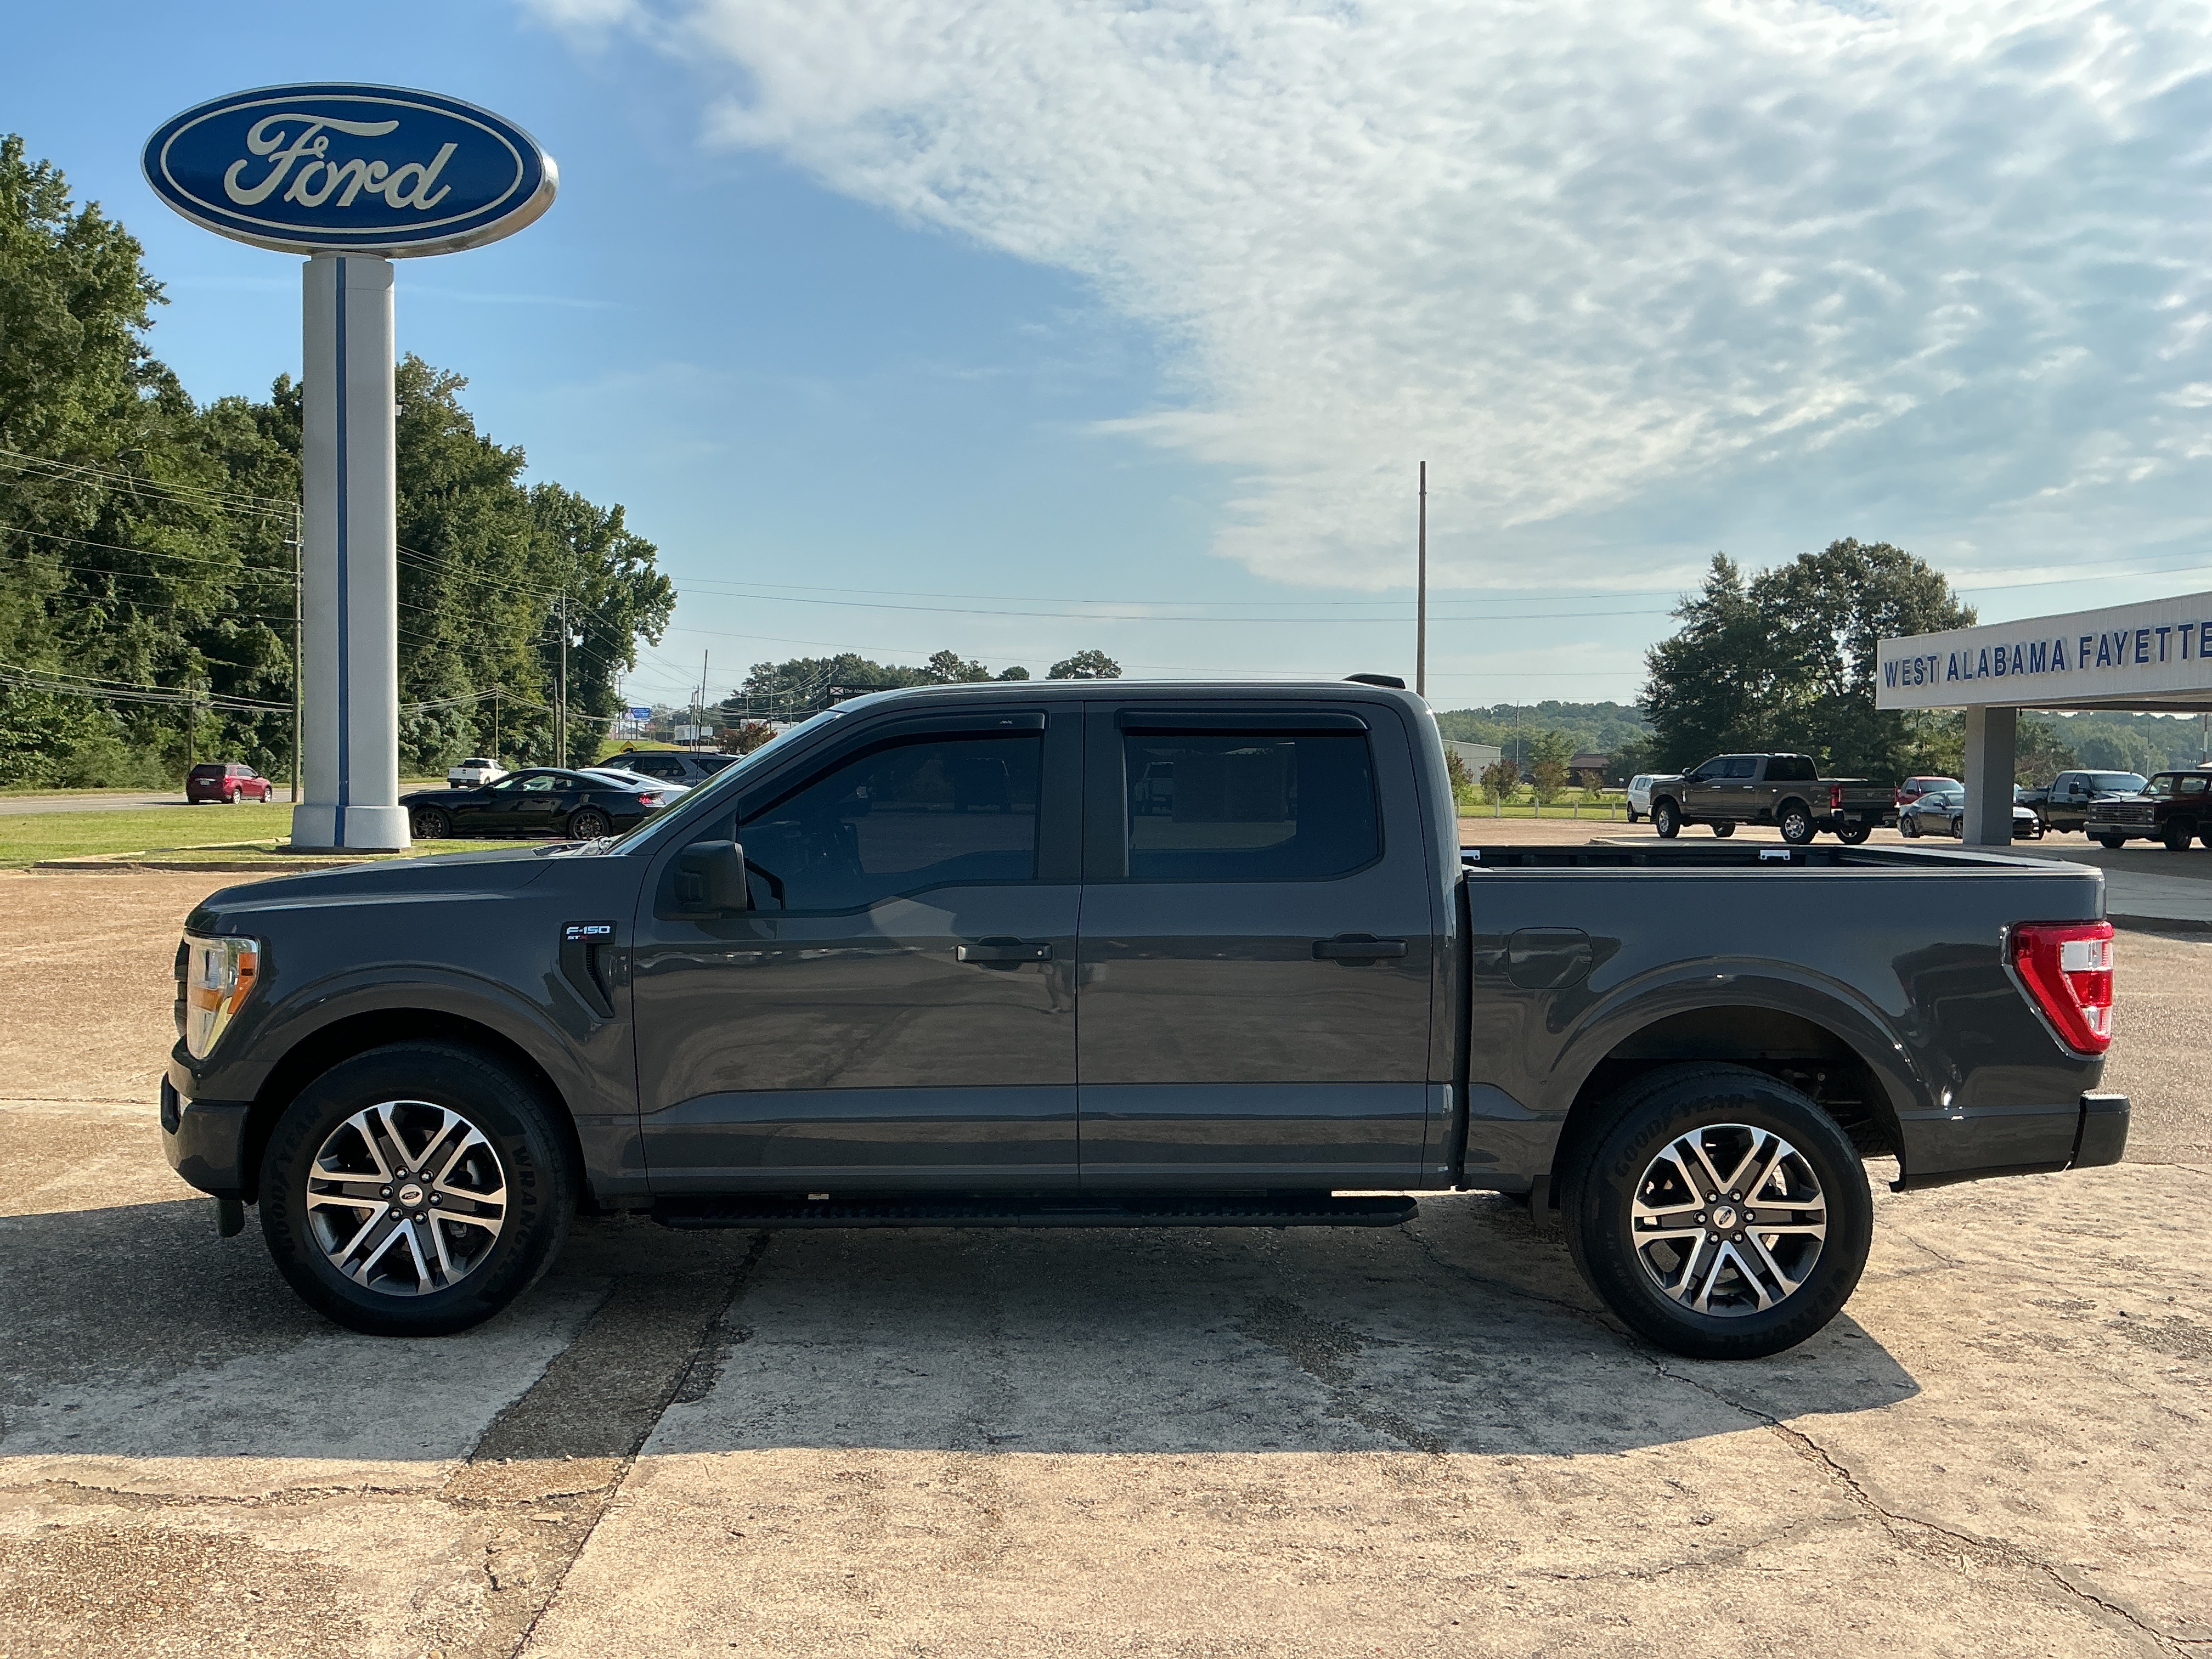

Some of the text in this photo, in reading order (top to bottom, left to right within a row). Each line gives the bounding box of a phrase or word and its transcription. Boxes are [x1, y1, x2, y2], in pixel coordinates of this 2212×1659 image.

[224, 113, 459, 210] Ford
[1884, 621, 2212, 688] WEST ALABAMA FAYETTE
[566, 926, 611, 935] F-150
